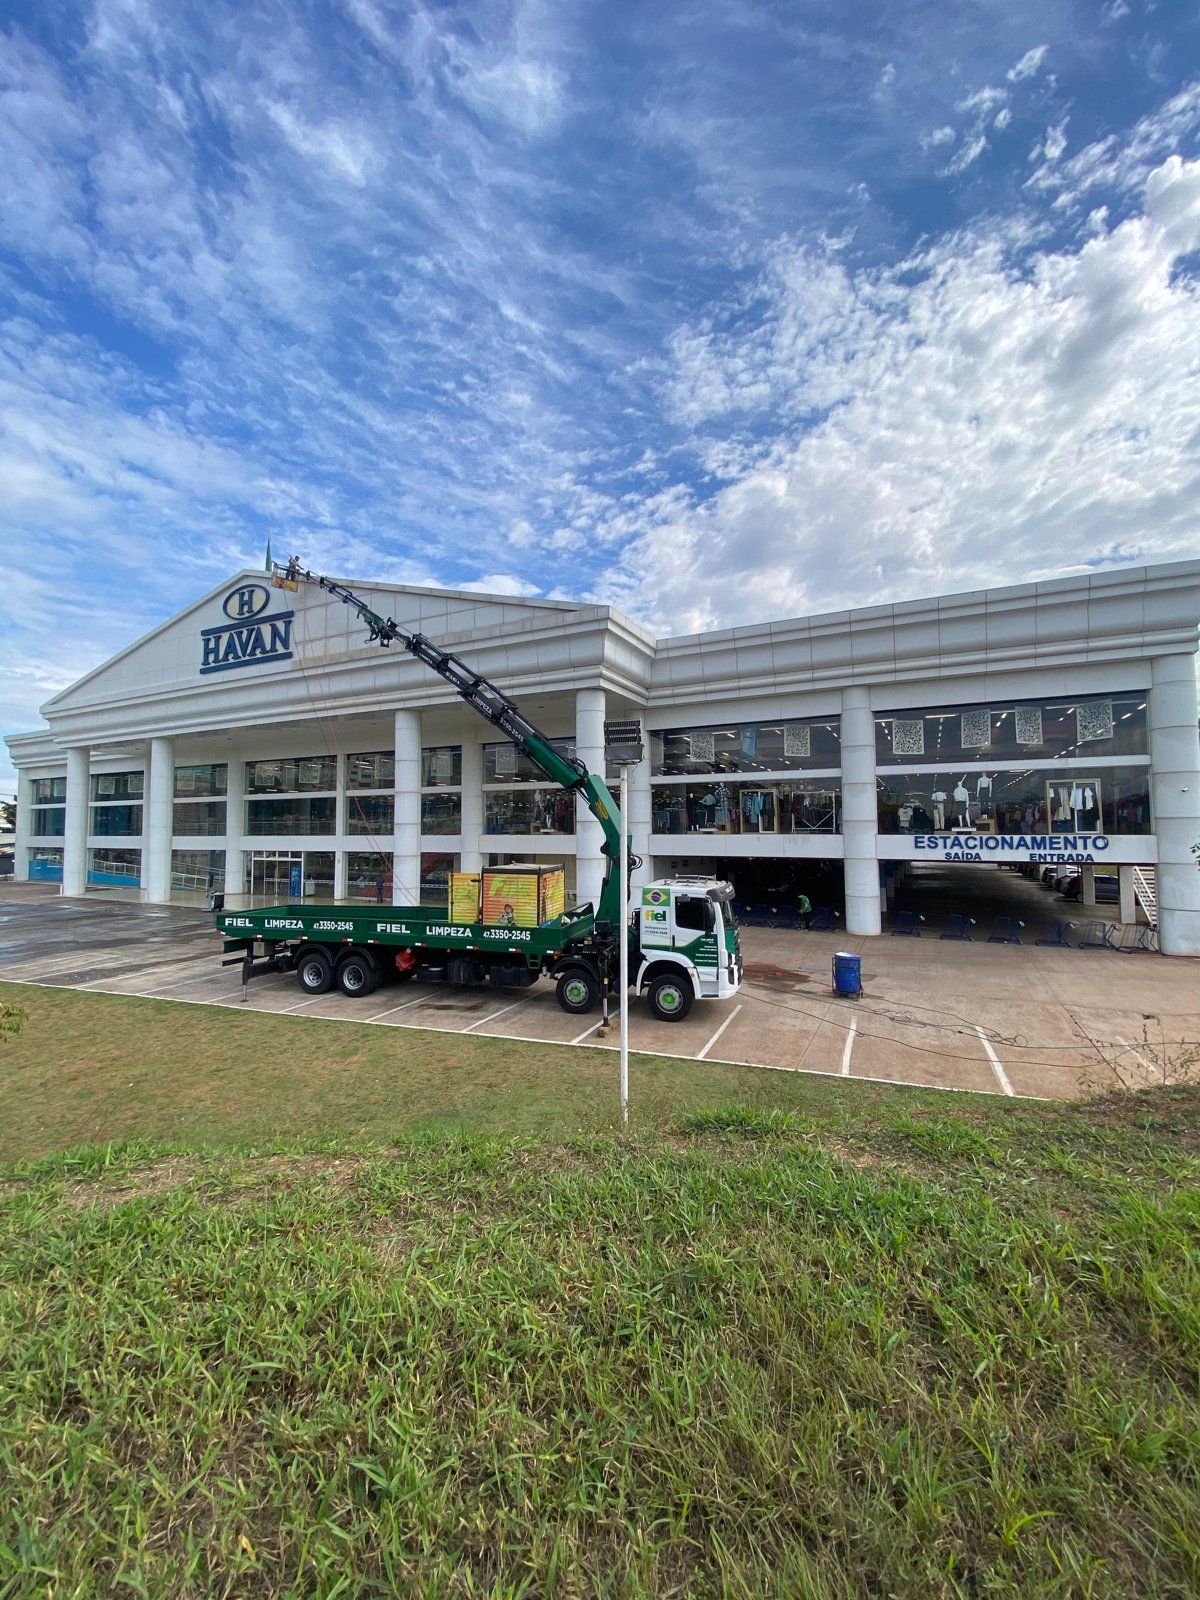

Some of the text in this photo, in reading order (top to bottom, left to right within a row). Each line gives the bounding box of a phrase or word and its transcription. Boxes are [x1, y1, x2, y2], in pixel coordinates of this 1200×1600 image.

[237, 589, 255, 616] H
[201, 619, 292, 666] HAVAN
[472, 693, 493, 716] LIMPEZA
[914, 835, 1109, 850] ESTACIONAMENTO
[944, 851, 1094, 862] SAÍDA ENTRADA
[224, 917, 253, 927] FIEL
[264, 918, 304, 929] LIMPEZA
[645, 909, 667, 922] fiel
[376, 923, 411, 934] FIEL
[426, 926, 472, 938] LIMPEZA
